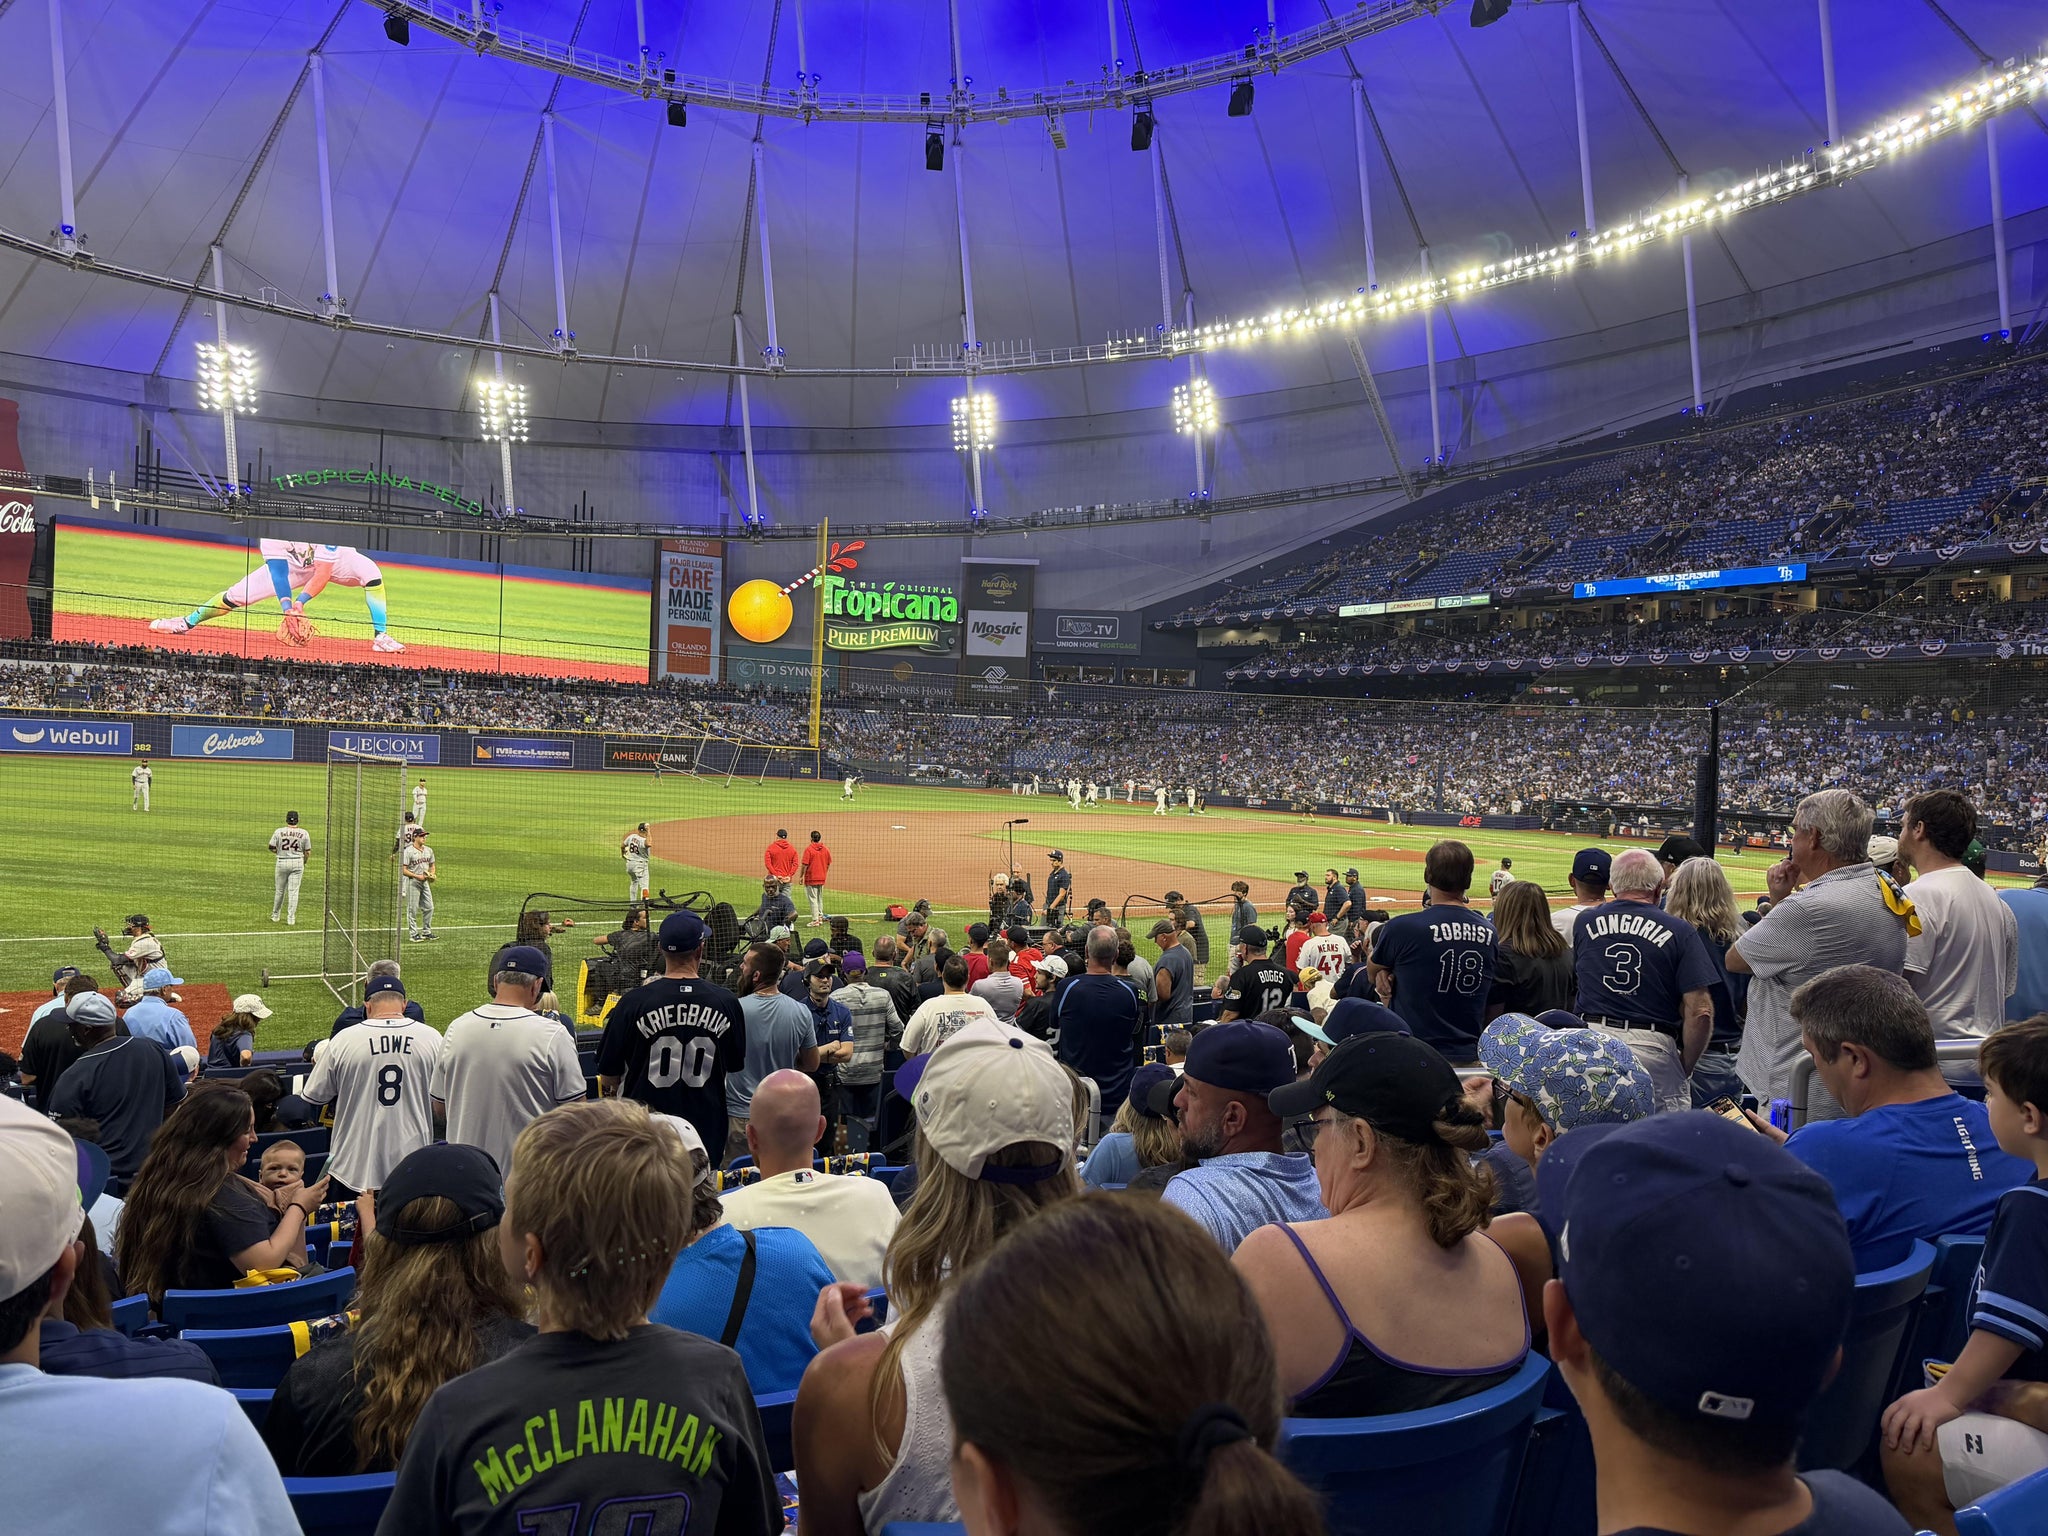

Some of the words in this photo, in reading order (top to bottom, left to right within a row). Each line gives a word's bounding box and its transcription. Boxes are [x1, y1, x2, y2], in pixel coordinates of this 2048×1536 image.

[272, 469, 413, 491] TROPICANA
[419, 481, 484, 516] FIELD
[670, 558, 690, 567] MAJOR
[692, 561, 713, 570] LEAGUE
[669, 566, 713, 591] CARE
[981, 579, 1000, 588] Hard
[1000, 580, 1018, 590] Rock
[899, 584, 953, 594] ORIGINAL
[668, 588, 713, 611] MADE
[813, 575, 958, 622] Tropicana
[668, 608, 712, 622] PERSONAL
[828, 627, 867, 646] PURE
[870, 626, 939, 645] PREMIUM
[972, 621, 1022, 635] Mosaic
[671, 641, 707, 651] ORLANDO
[1080, 641, 1099, 649] HOME
[759, 665, 776, 675] TD
[851, 682, 882, 693] DREAM
[885, 684, 919, 695] FINDERS
[921, 686, 953, 696] HOMES
[50, 728, 119, 746] Webull
[202, 730, 265, 755] Culver's
[344, 737, 424, 753] LECOM
[134, 743, 151, 751] 382
[495, 746, 570, 757] MicroLumen
[612, 752, 661, 762] AMERANT
[663, 753, 688, 763] BANK
[1459, 816, 1482, 825] ACE
[282, 839, 299, 851] 24
[1430, 922, 1494, 947] ZOBRIST
[1586, 914, 1673, 949] LONGORIA
[1318, 943, 1339, 953] MEANS
[1317, 954, 1343, 976] 47
[1438, 949, 1484, 995] 18
[1603, 942, 1642, 994] 3
[1258, 969, 1285, 984] BOGGS
[1261, 987, 1283, 1011] 12
[368, 1034, 414, 1056] LOWE
[648, 1035, 717, 1089] 00
[378, 1064, 403, 1107] 8
[1952, 1116, 1984, 1182] LIGHTNING
